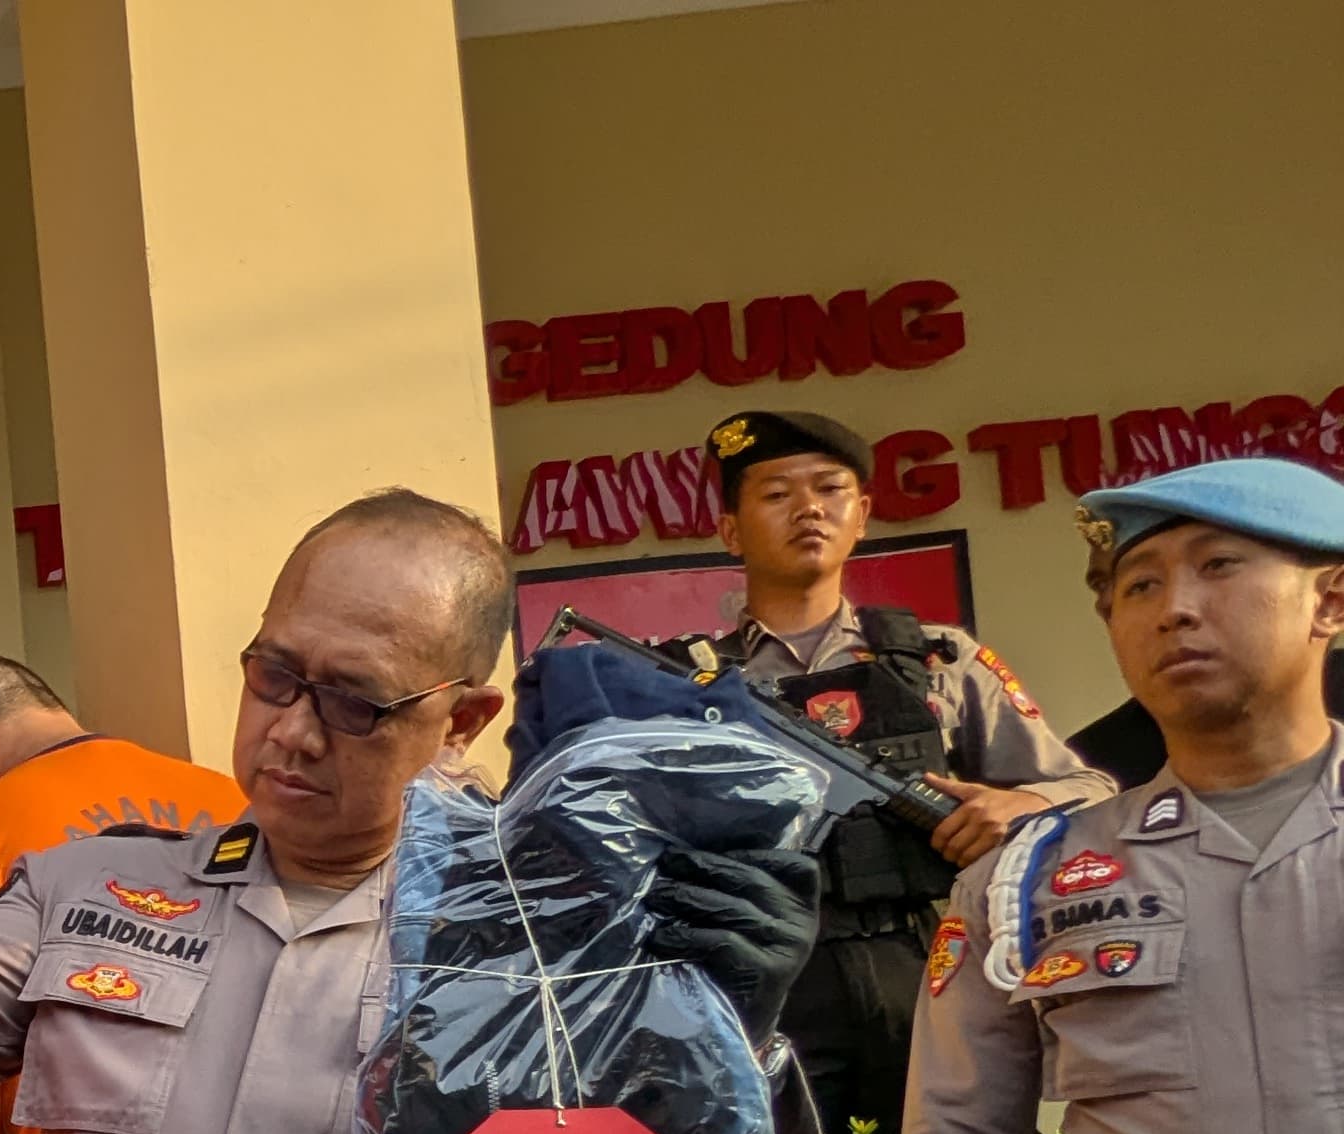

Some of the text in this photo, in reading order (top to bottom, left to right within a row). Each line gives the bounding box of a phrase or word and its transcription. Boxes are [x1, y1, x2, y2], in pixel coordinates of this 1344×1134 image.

[488, 280, 966, 404] GEDUNG
[62, 908, 208, 964] UBAIDILLAH
[1052, 898, 1129, 933] BIMA
[1138, 894, 1161, 918] S
